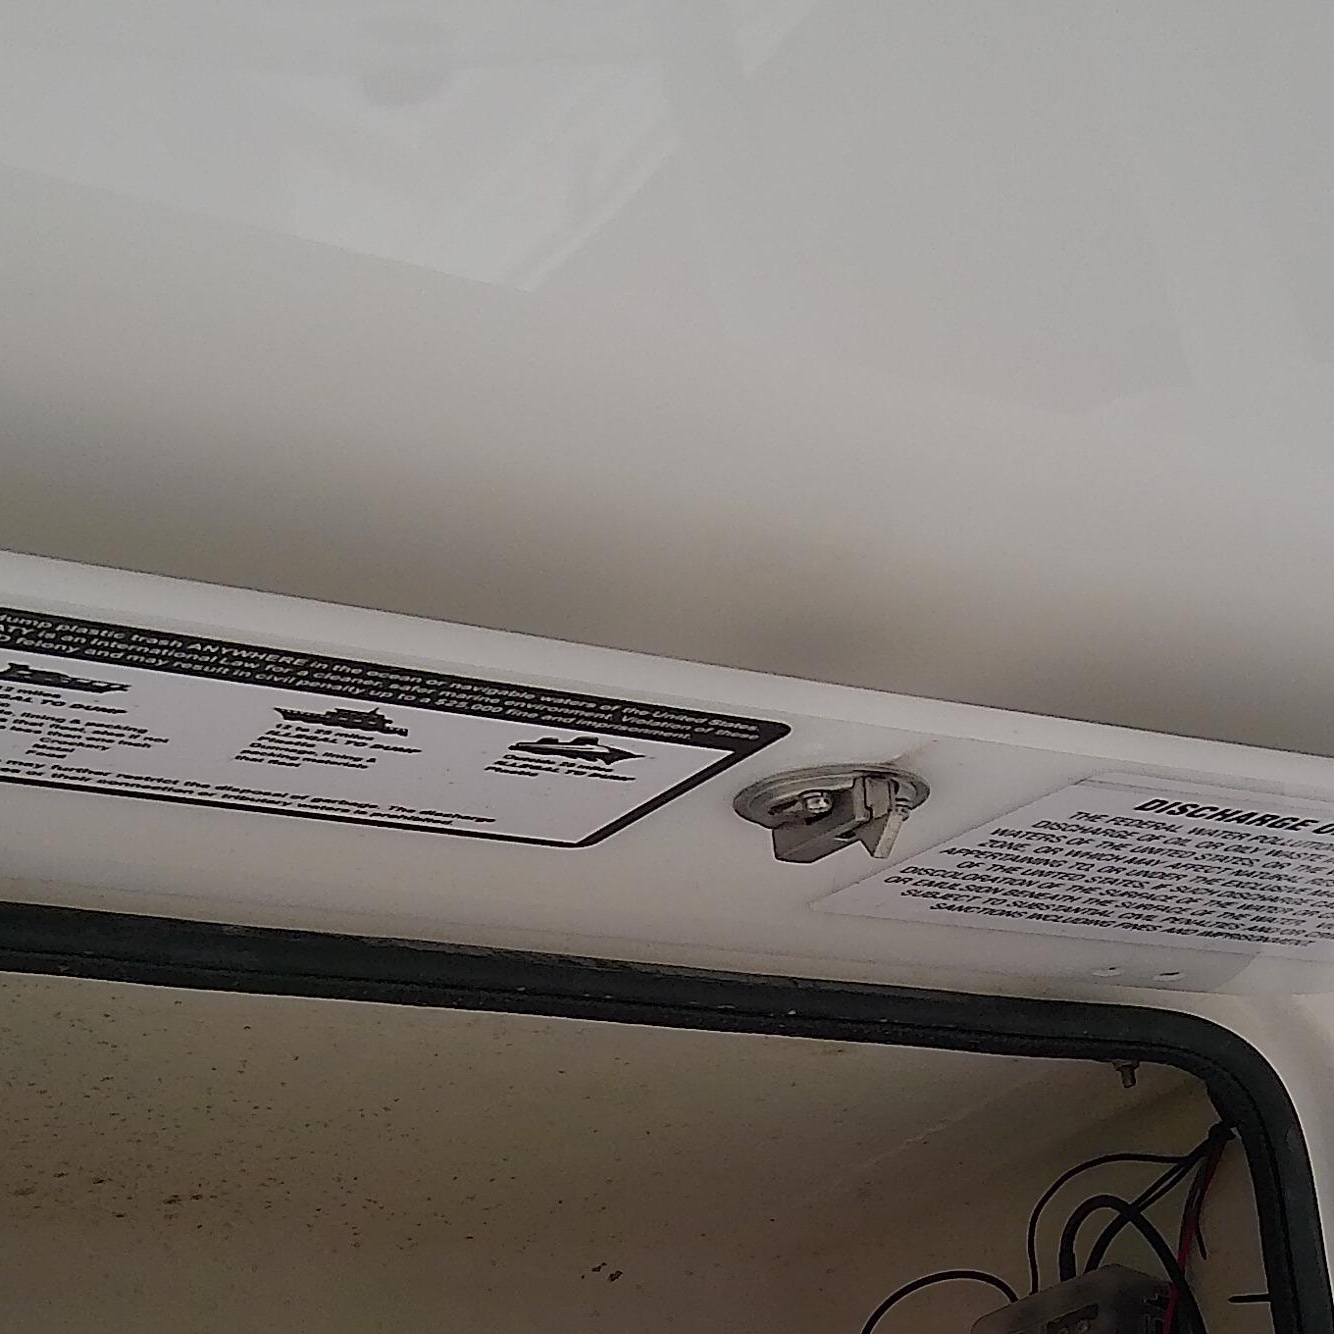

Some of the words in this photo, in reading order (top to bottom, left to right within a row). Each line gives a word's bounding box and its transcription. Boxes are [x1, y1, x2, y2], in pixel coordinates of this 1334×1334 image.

[16, 637, 79, 652] felony
[84, 648, 124, 658] and
[126, 654, 168, 666] may
[172, 661, 229, 673] result
[255, 673, 295, 683] civil
[295, 679, 364, 694] penalty
[435, 698, 502, 712] $25,000
[505, 708, 538, 718] fine
[541, 715, 575, 723] and
[55, 624, 124, 638] plastic
[131, 634, 182, 647] trash
[187, 643, 307, 665] ANYWHERE
[332, 664, 362, 673] the
[366, 670, 421, 682] ocean
[449, 683, 534, 699] navigable
[540, 696, 596, 707] waters
[622, 707, 650, 715] the
[652, 711, 707, 723] United
[60, 635, 86, 643] an
[90, 638, 217, 661] International
[218, 657, 259, 668] Law
[264, 664, 292, 672] for
[389, 683, 436, 693] safer
[438, 690, 499, 703] marine
[621, 715, 691, 729] Violation
[714, 729, 758, 739] these
[1069, 811, 1108, 822] THE
[1105, 816, 1182, 832] FEDERAL
[1187, 827, 1250, 840] WATER
[1135, 799, 1317, 830] DISCHARGE
[991, 828, 1067, 842] WATERS
[1065, 837, 1094, 845] OF
[1095, 840, 1132, 850] THE
[1129, 845, 1196, 858] UNITED
[1292, 864, 1327, 873] THE
[1032, 820, 1138, 839] DISCHARGE
[1136, 833, 1166, 841] OF
[1162, 837, 1191, 846] OIL
[1194, 841, 1224, 849] OR
[1223, 844, 1265, 853] OILY
[1264, 849, 1326, 861] WASTE
[940, 847, 1067, 867] APPERTAINING
[1125, 869, 1187, 880] UNDER
[1189, 875, 1225, 885] THE
[1221, 879, 1308, 894] EXCLUSIVE
[985, 863, 1023, 874] THE
[1020, 868, 1085, 881] UNITED
[1169, 885, 1220, 895] SUCH
[1217, 890, 1309, 905] DISCHARGE
[1033, 845, 1063, 854] OR
[1064, 849, 1127, 862] WHICH
[1122, 856, 1167, 866] MAY
[1164, 862, 1232, 874] AFFECT
[1228, 869, 1302, 883] NATURAL
[900, 866, 1039, 886] DISCOLORATION
[1065, 884, 1101, 894] THE
[1099, 888, 1177, 902] SURFACE
[1236, 903, 1293, 913] WATER
[901, 889, 981, 902] SUBJECT
[982, 897, 1007, 905] TO
[1006, 900, 1113, 917] SUBSTANTIAL
[1117, 912, 1157, 921] CIVIL
[1160, 916, 1244, 929] PENALTIES
[912, 879, 1004, 894] EMULSION
[1002, 889, 1081, 902] BENEATH
[1081, 897, 1116, 906] THE
[1114, 901, 1191, 914] SURFACE
[930, 902, 1027, 917] SANCTIONS
[1026, 913, 1115, 927] INCLUDING
[1113, 922, 1162, 931] FINES
[1160, 927, 1198, 935] AND
